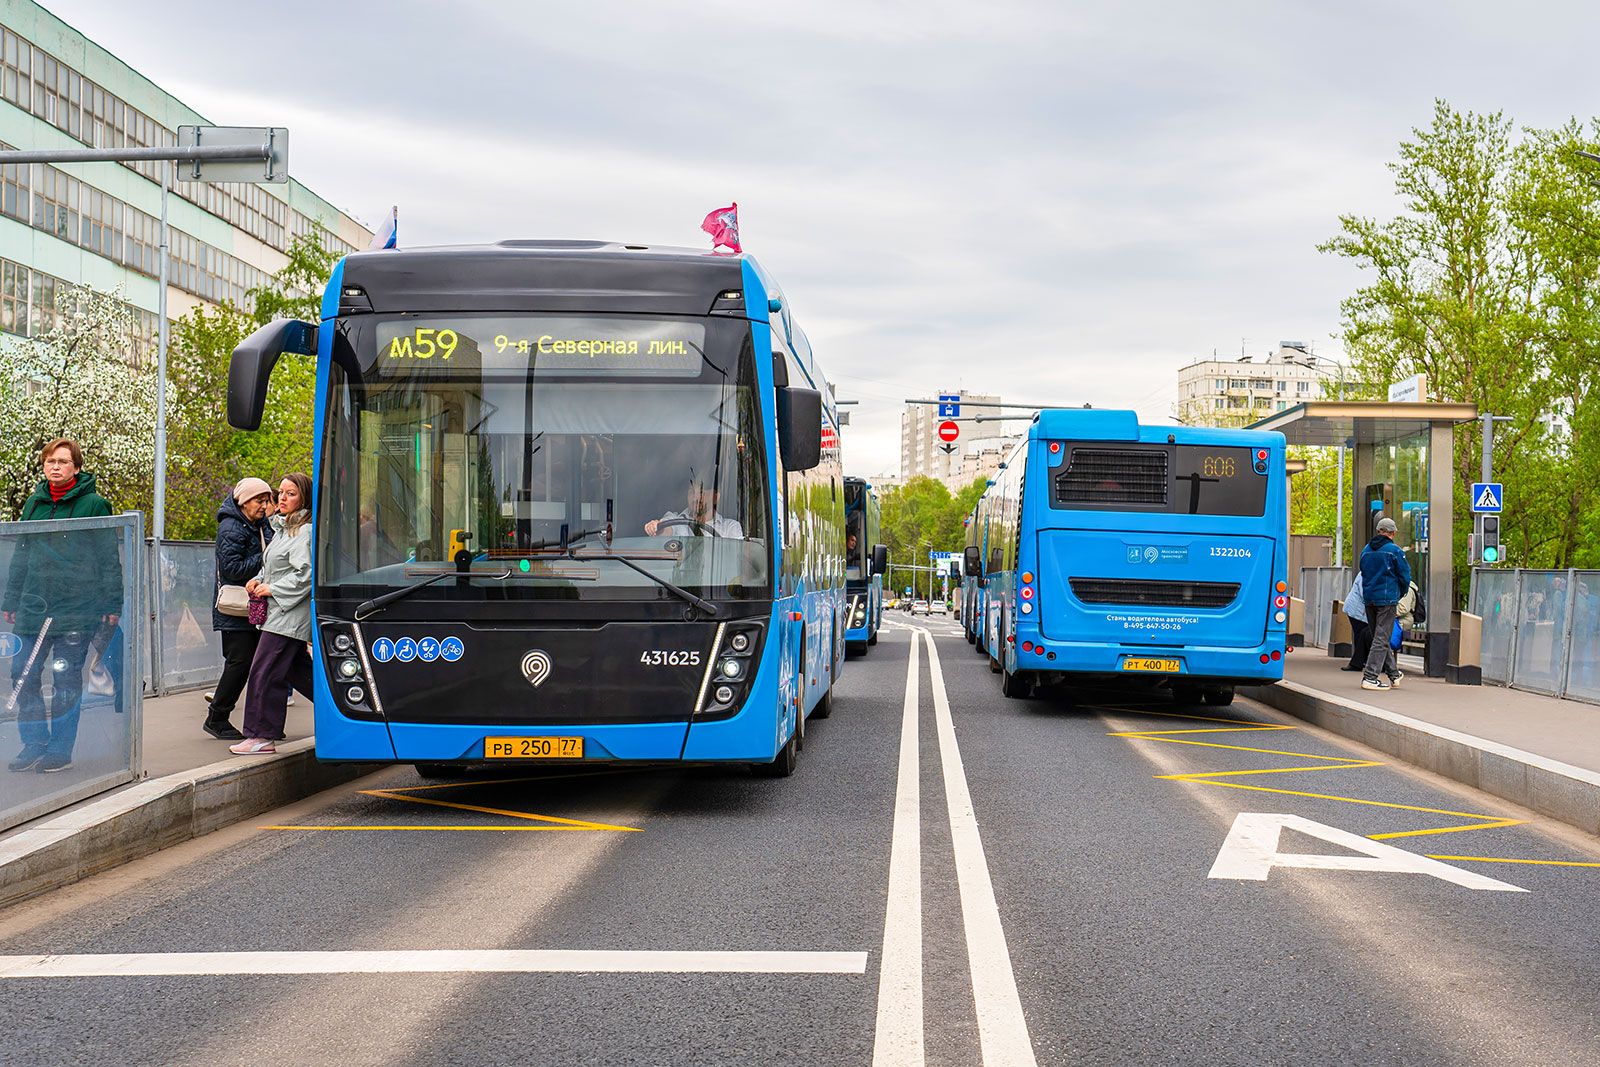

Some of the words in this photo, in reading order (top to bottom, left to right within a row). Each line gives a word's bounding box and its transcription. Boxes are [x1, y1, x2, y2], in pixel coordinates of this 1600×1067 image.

[494, 334, 529, 354] 9-я
[537, 334, 638, 358] Северная
[647, 339, 688, 355] лин.
[1204, 456, 1235, 478] 606
[1209, 547, 1252, 558] 1322104
[1106, 614, 1127, 622] Стань
[1166, 616, 1199, 625] автобуса!
[640, 650, 700, 666] 431625
[1127, 661, 1140, 669] РТ
[1143, 660, 1162, 670] 400
[1167, 660, 1177, 668] 77
[493, 743, 512, 756] РВ
[520, 740, 551, 756] 250
[561, 739, 577, 751] 77
